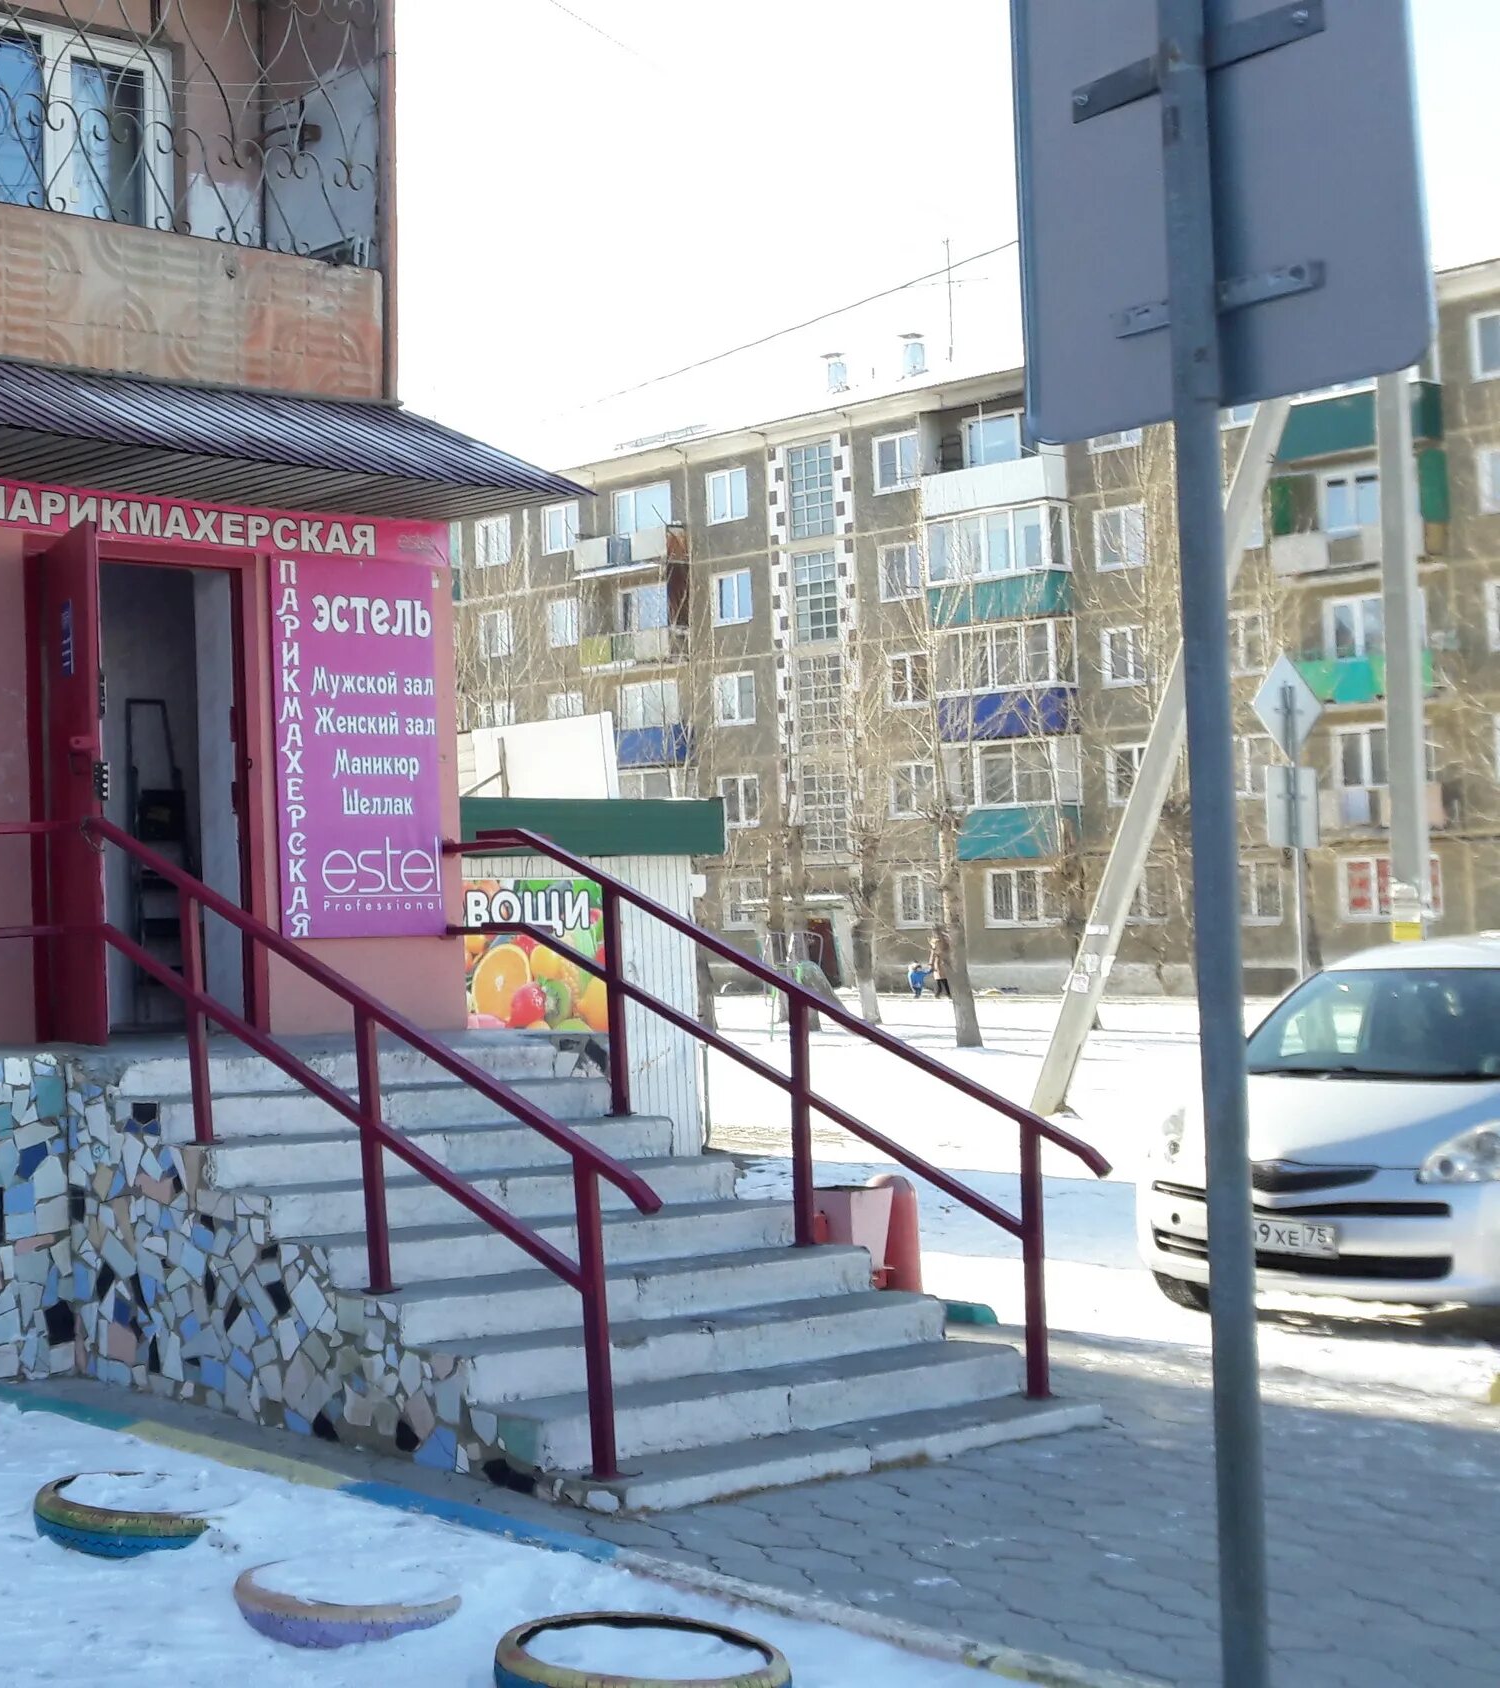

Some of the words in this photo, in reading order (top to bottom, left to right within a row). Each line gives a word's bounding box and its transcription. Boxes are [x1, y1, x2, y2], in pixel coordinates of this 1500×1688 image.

[310, 666, 398, 699] Мужской
[403, 677, 434, 696] зал
[314, 706, 399, 736] Женский
[404, 717, 436, 736] зал
[276, 559, 312, 937] ПАРИКМАХЕРСКАЯ
[332, 748, 420, 782] Маникюр
[342, 787, 414, 816] Шеллак
[321, 835, 442, 894] estel
[323, 897, 442, 912] Professional
[464, 888, 591, 938] ВОЩИ
